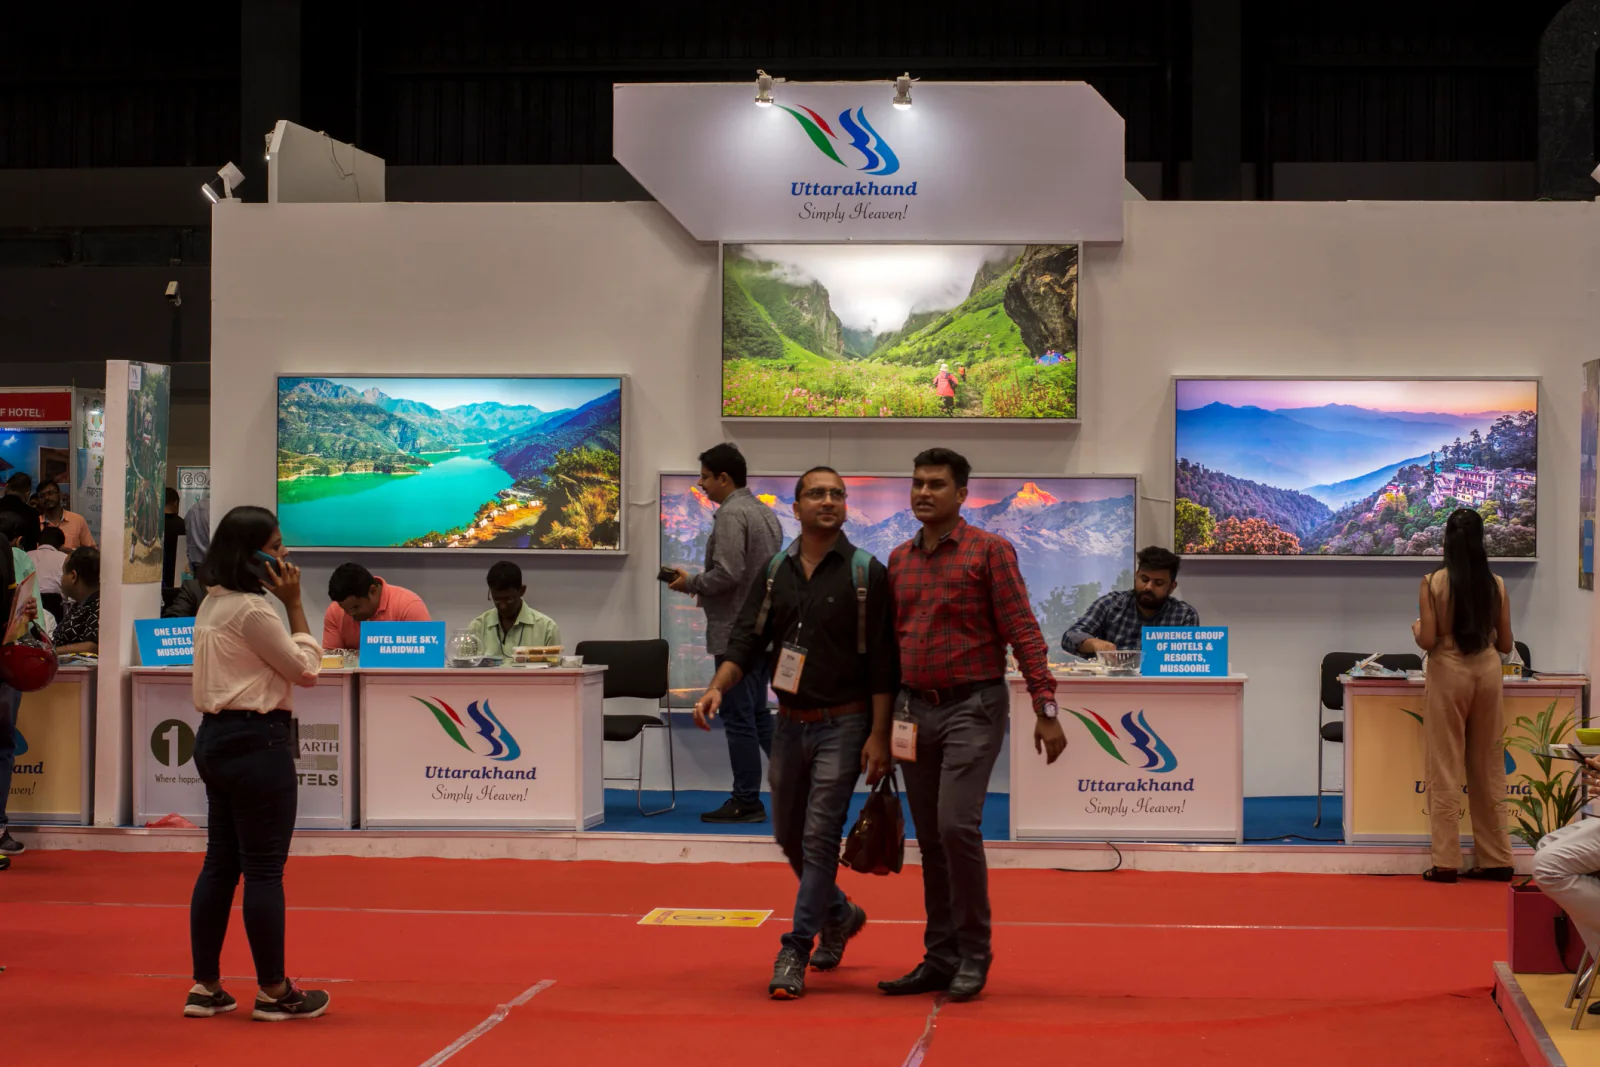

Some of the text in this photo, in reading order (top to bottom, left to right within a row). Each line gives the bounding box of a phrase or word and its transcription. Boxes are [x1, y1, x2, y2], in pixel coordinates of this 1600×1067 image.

[791, 181, 918, 196] Uttarakhand
[798, 201, 909, 223] Simply Heaven!
[181, 471, 210, 485] GO
[154, 627, 171, 637] ONE
[1145, 631, 1225, 640] LAWRENCE GROUP
[366, 635, 439, 645] HOTEL BLUE SKY,
[379, 645, 425, 654] HARIDWAR
[1156, 642, 1213, 651] OF HOTELS &
[1164, 653, 1206, 663] RESORTS,
[1159, 664, 1211, 673] MUSSOORIE
[424, 765, 537, 780] Uttarakhand
[155, 773, 177, 783] Where
[1077, 778, 1195, 792] Uttarakhand
[431, 783, 529, 804] Simply Heaven!
[1084, 797, 1186, 816] Simply Heaven!
